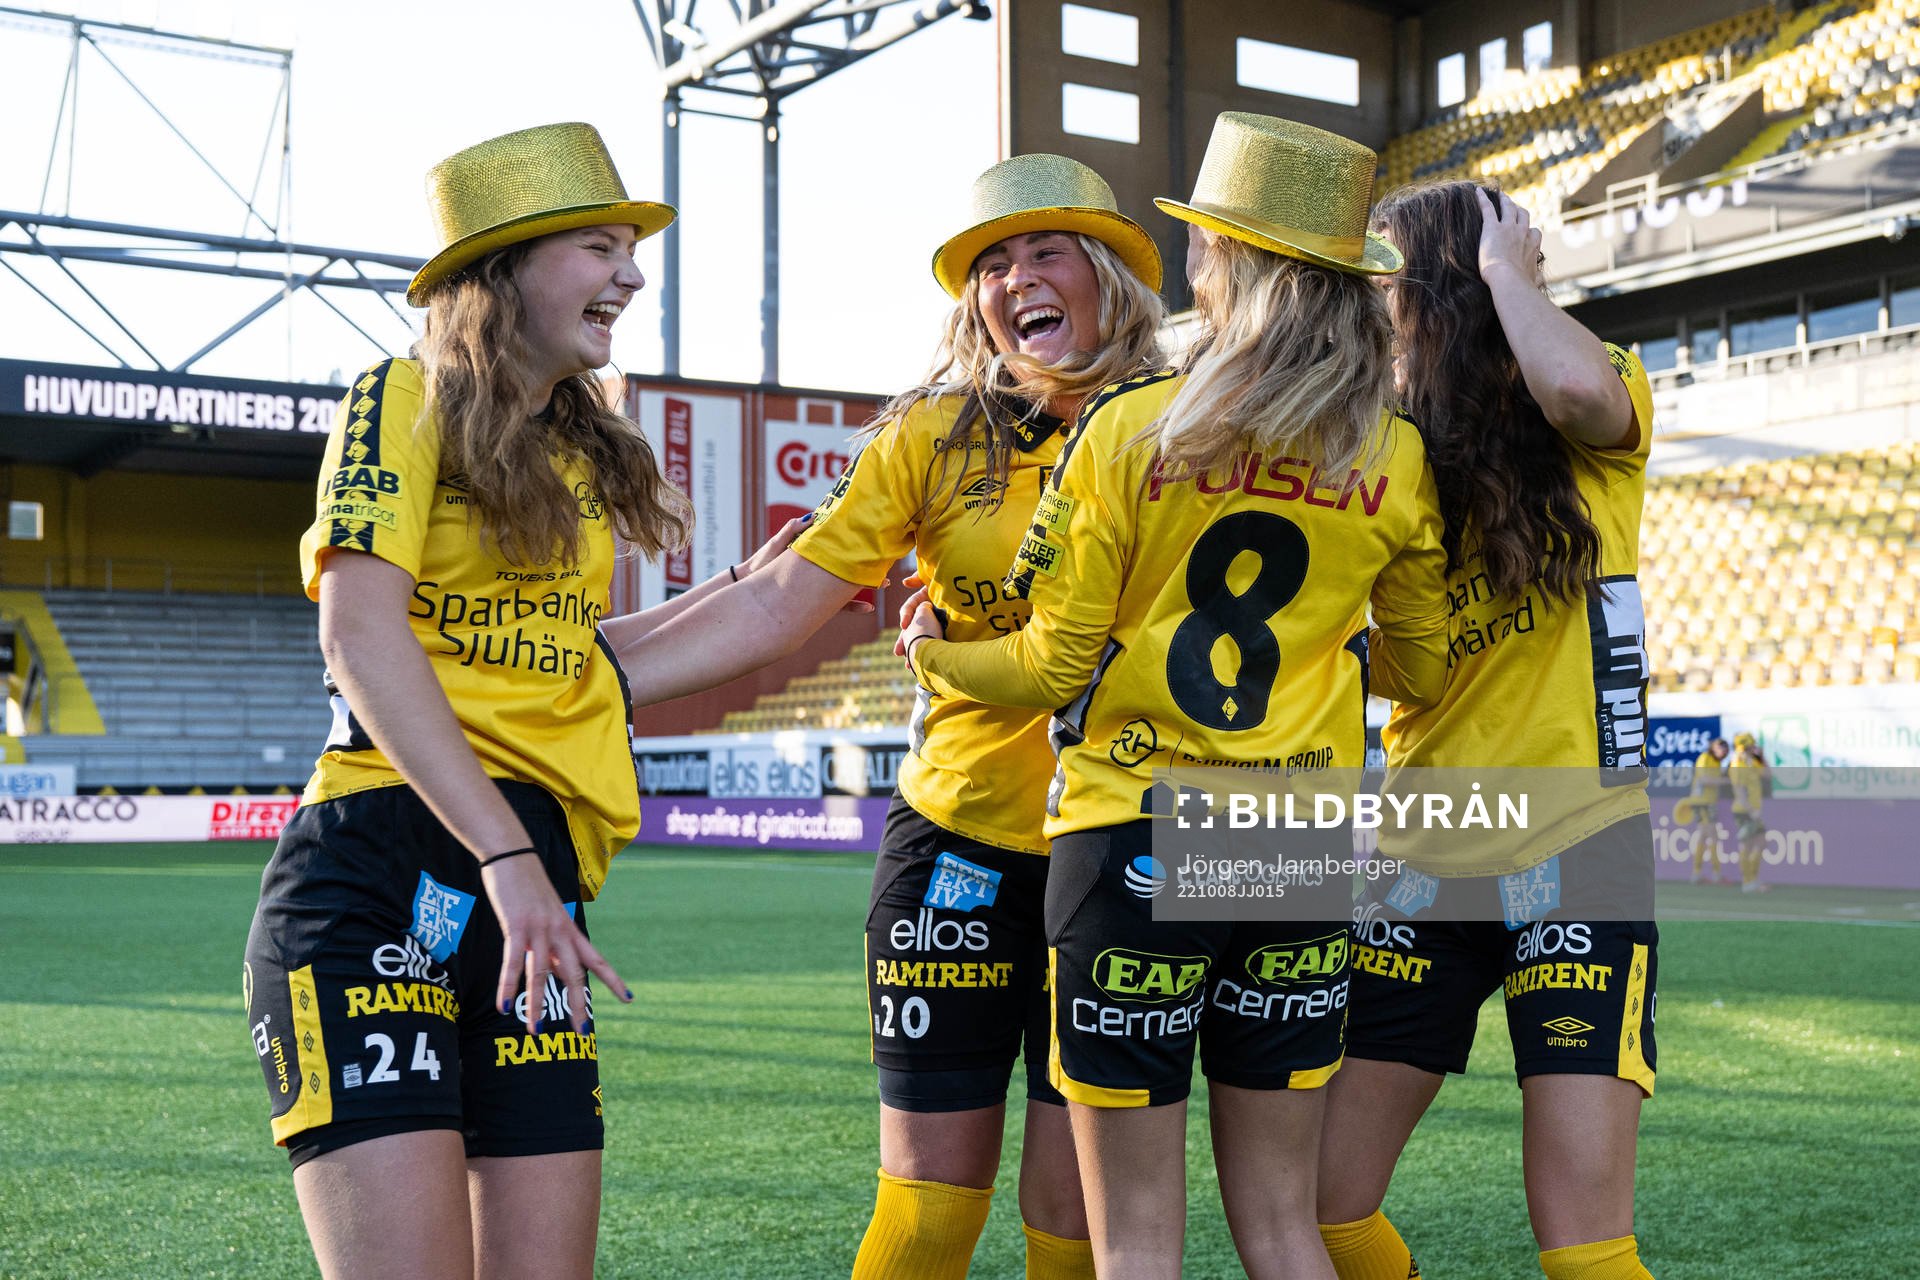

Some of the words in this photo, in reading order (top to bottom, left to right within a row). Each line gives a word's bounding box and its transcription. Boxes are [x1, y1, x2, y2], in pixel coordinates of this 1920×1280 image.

[24, 374, 295, 432] HUVUDPARTNERS
[298, 396, 341, 434] 20
[669, 406, 689, 447] BIL
[1148, 451, 1390, 517] PULSEN
[1166, 510, 1310, 731] 8
[437, 627, 590, 680] Sjuhära
[1285, 746, 1334, 778] GROUP
[929, 885, 963, 908] IV
[934, 872, 994, 899] EKT
[1401, 864, 1436, 898] EKT
[1508, 872, 1556, 906] EKT
[890, 906, 991, 951] ellos
[1508, 903, 1531, 927] IV
[1257, 937, 1346, 981] EAB
[1516, 916, 1593, 962] ellos
[876, 959, 1014, 989] RAMIRENT
[1103, 954, 1206, 996] EAB
[1505, 962, 1613, 1001] RAMIRENT
[880, 995, 931, 1039] 20
[364, 1031, 442, 1085] 24
[1546, 1035, 1588, 1049] umbro
[271, 1036, 290, 1094] umbro
